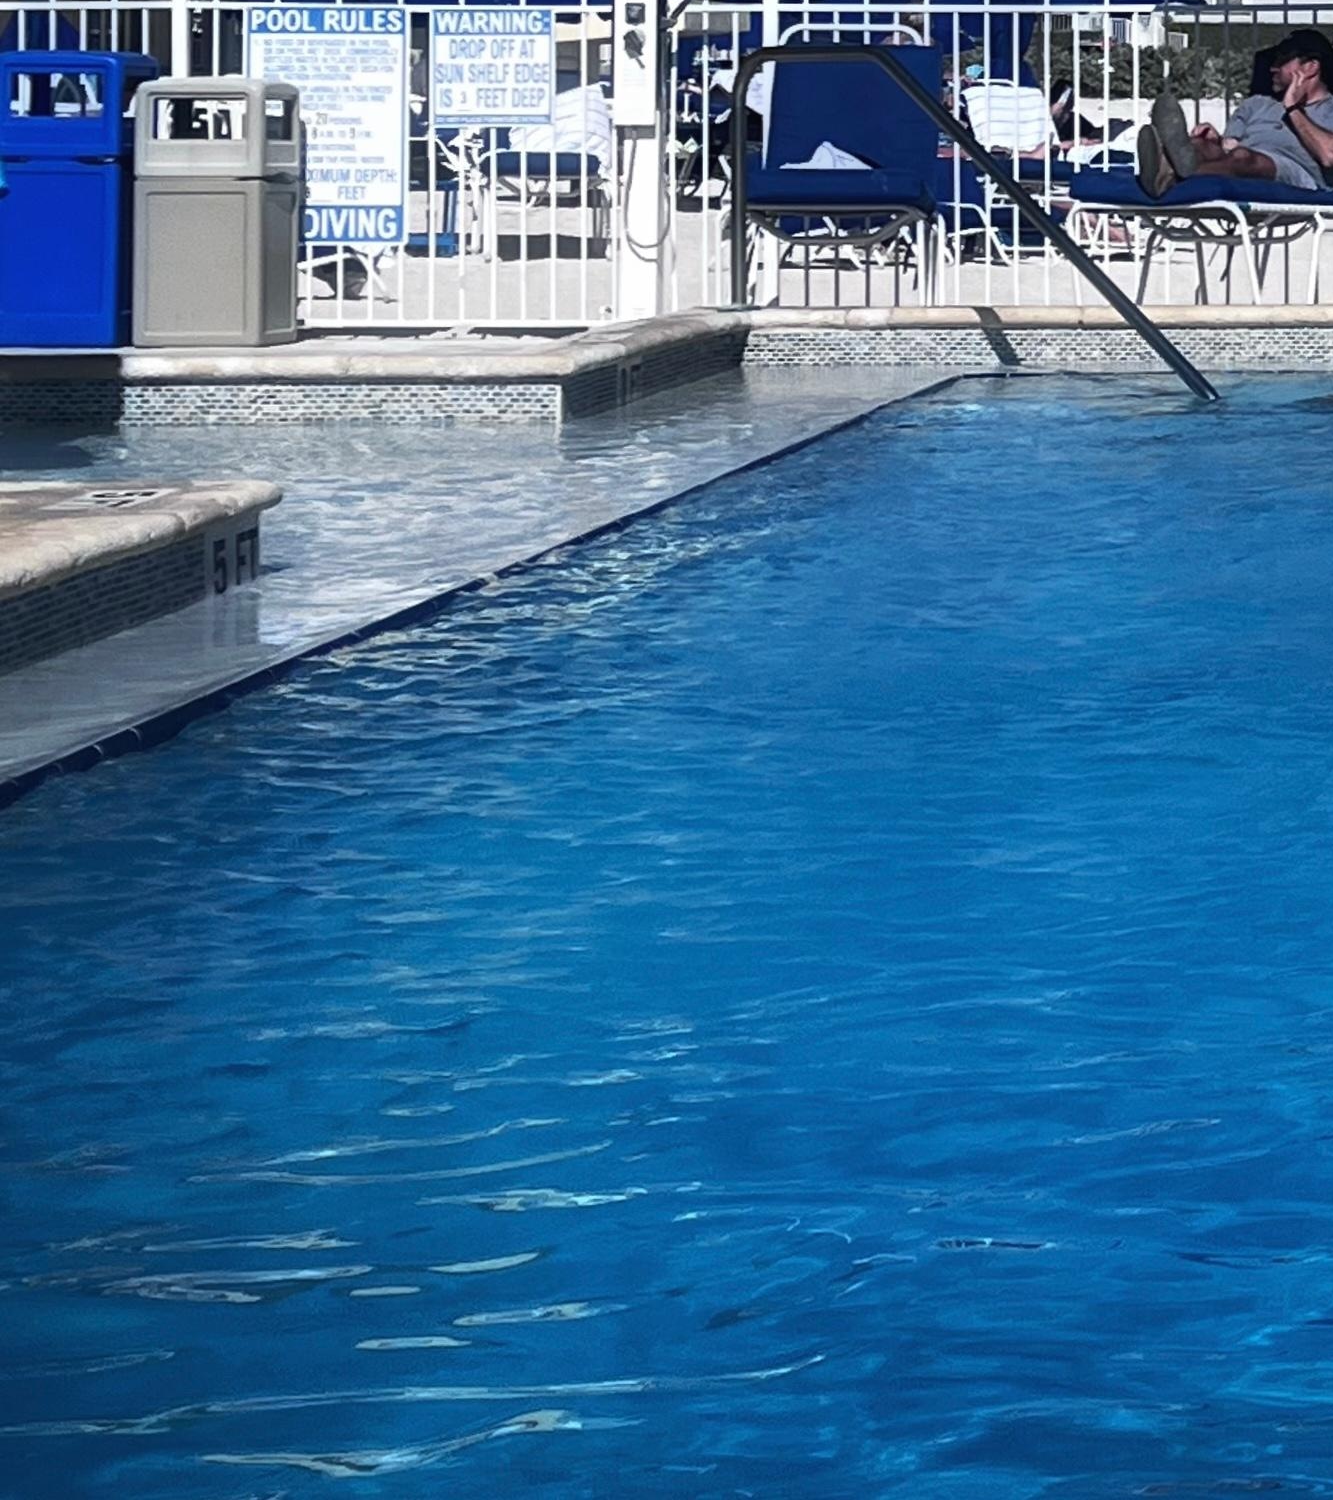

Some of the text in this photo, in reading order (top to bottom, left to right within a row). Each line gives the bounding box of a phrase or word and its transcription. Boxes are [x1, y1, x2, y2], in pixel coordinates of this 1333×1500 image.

[251, 9, 403, 32] POOL RULES
[436, 10, 550, 34] WARNING:
[449, 38, 536, 60] DROP OFF AT
[434, 63, 550, 84] SUN SHELF EDGE
[439, 87, 453, 108] IS
[476, 87, 508, 109] FEET
[511, 87, 546, 108] DEEP
[337, 185, 366, 200] FEET
[212, 538, 228, 595] 5
